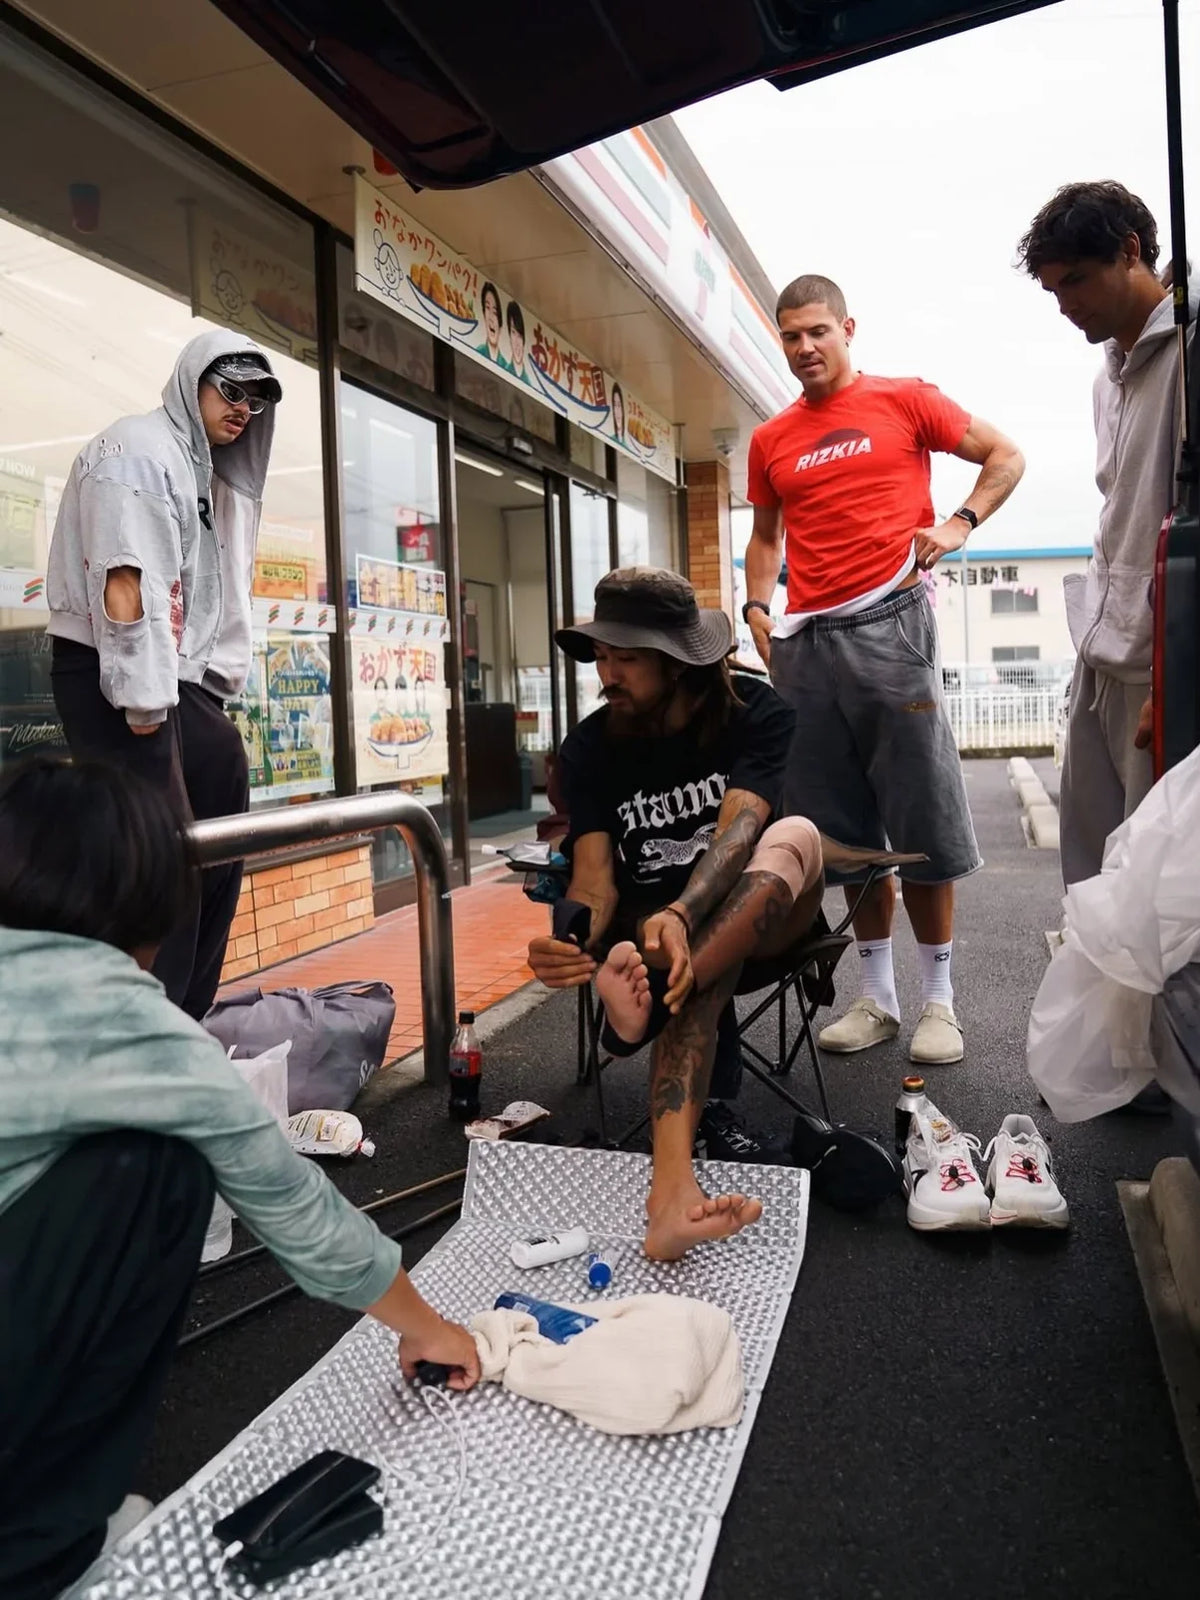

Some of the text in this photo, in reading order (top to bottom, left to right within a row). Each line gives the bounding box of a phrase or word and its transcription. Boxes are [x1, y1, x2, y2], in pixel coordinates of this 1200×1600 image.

[531, 322, 608, 407] おかず天国
[794, 437, 872, 474] RIZKIA
[360, 642, 436, 684] おかず天国
[278, 679, 319, 694] HAPPY
